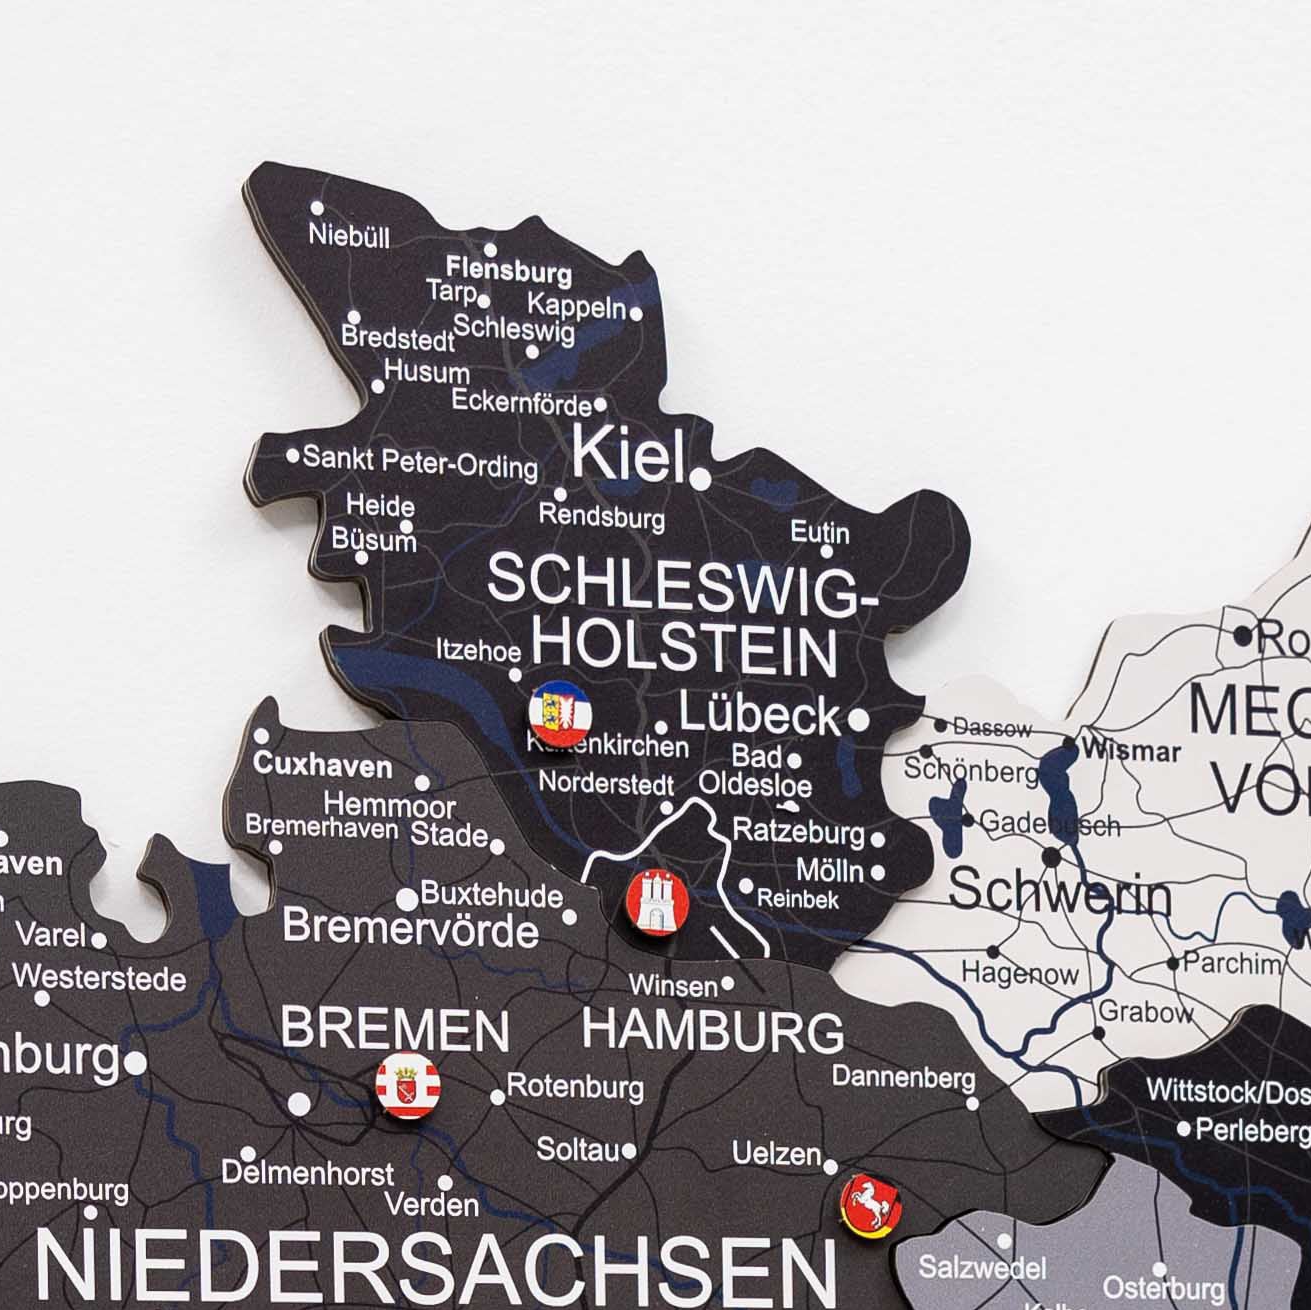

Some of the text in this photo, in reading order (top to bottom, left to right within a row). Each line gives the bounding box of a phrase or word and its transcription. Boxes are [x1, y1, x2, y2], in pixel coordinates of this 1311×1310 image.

[310, 222, 389, 248] Niebüll
[447, 255, 571, 289] Flensburg
[304, 444, 537, 485] Sankt Peter-Ording
[574, 422, 683, 483] Kiel
[488, 551, 879, 618] SCHLESWIG-
[533, 615, 836, 677] HOLSTEIN
[681, 689, 841, 736] Lübeck
[254, 750, 392, 778] Cuxhaven
[246, 813, 398, 838] Bremerhaven
[758, 888, 839, 909] Reinbek
[949, 864, 1172, 917] Schwerin
[283, 1005, 508, 1052] BREMEN
[584, 1007, 843, 1054] HAMBURG
[38, 1228, 836, 1308] NIEDERSACHSEN
[919, 1255, 1045, 1279] Salzwedel
